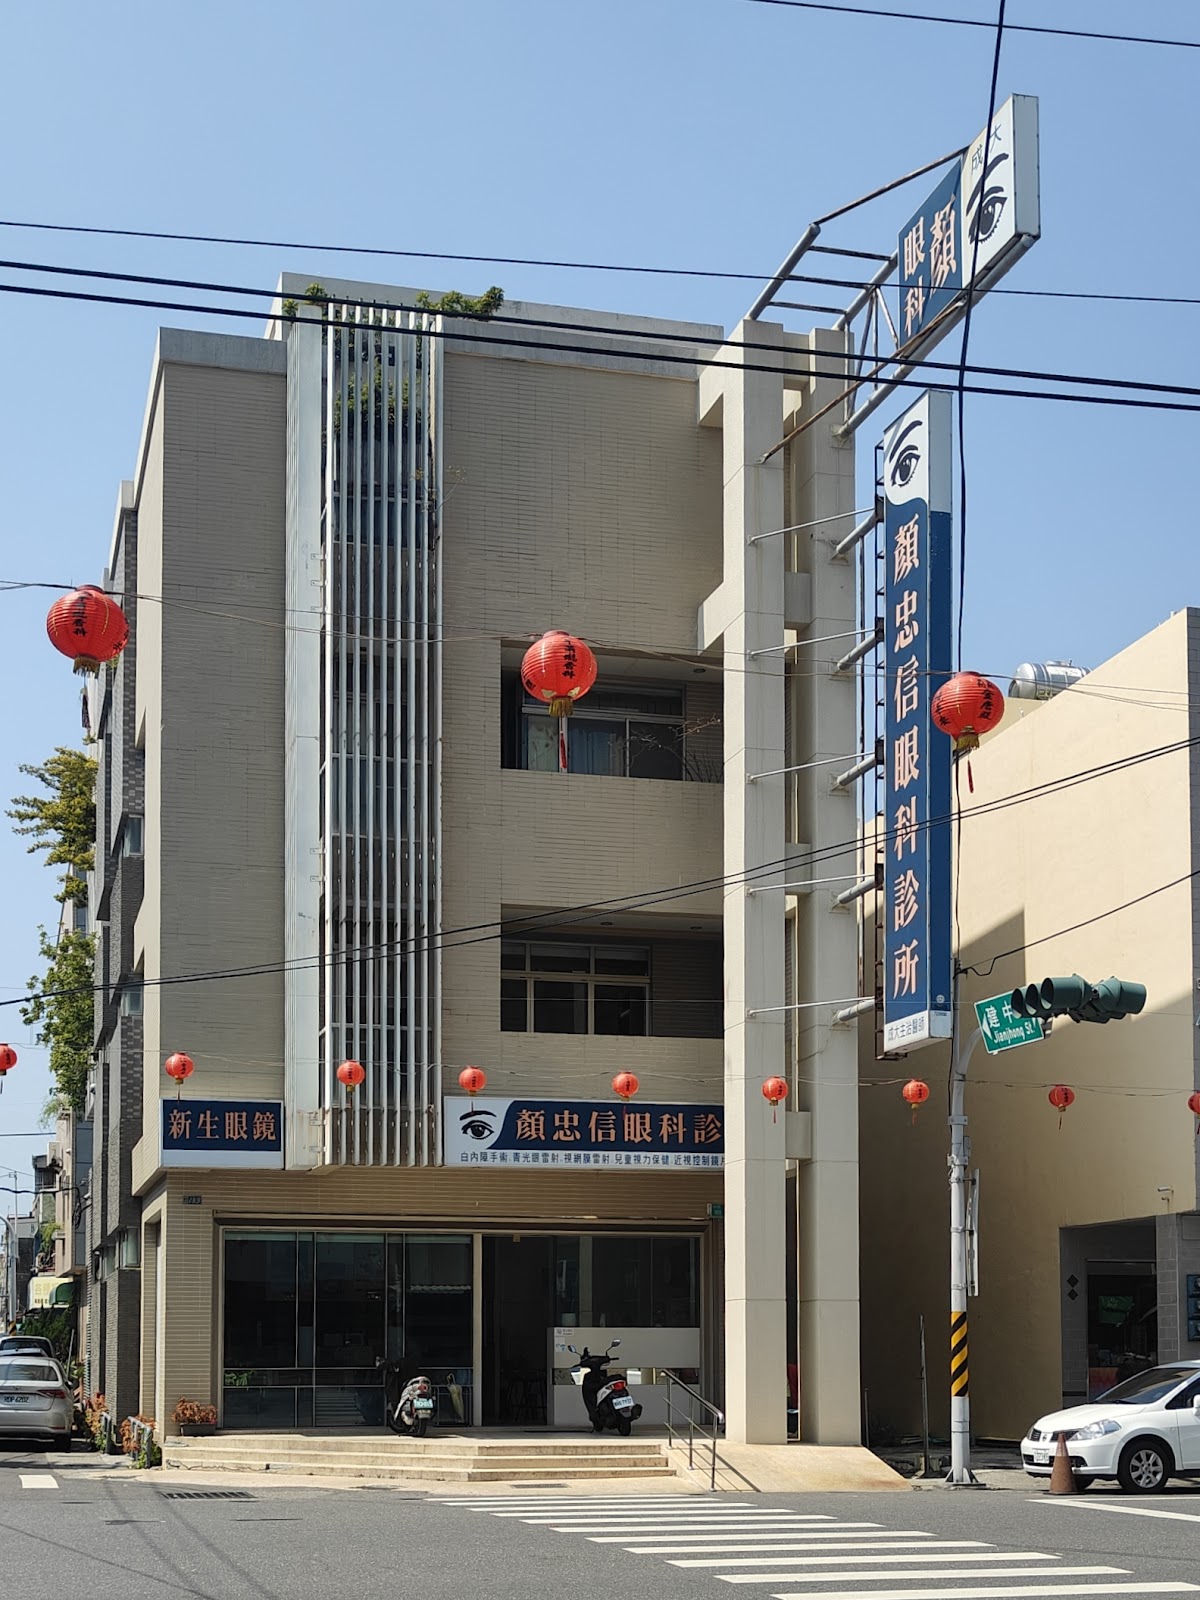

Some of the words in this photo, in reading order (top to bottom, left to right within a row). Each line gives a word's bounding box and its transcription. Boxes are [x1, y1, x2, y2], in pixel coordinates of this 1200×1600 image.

[893, 512, 920, 1000] 顏忠信眼科診所
[167, 1108, 277, 1141] 新生眼鏡
